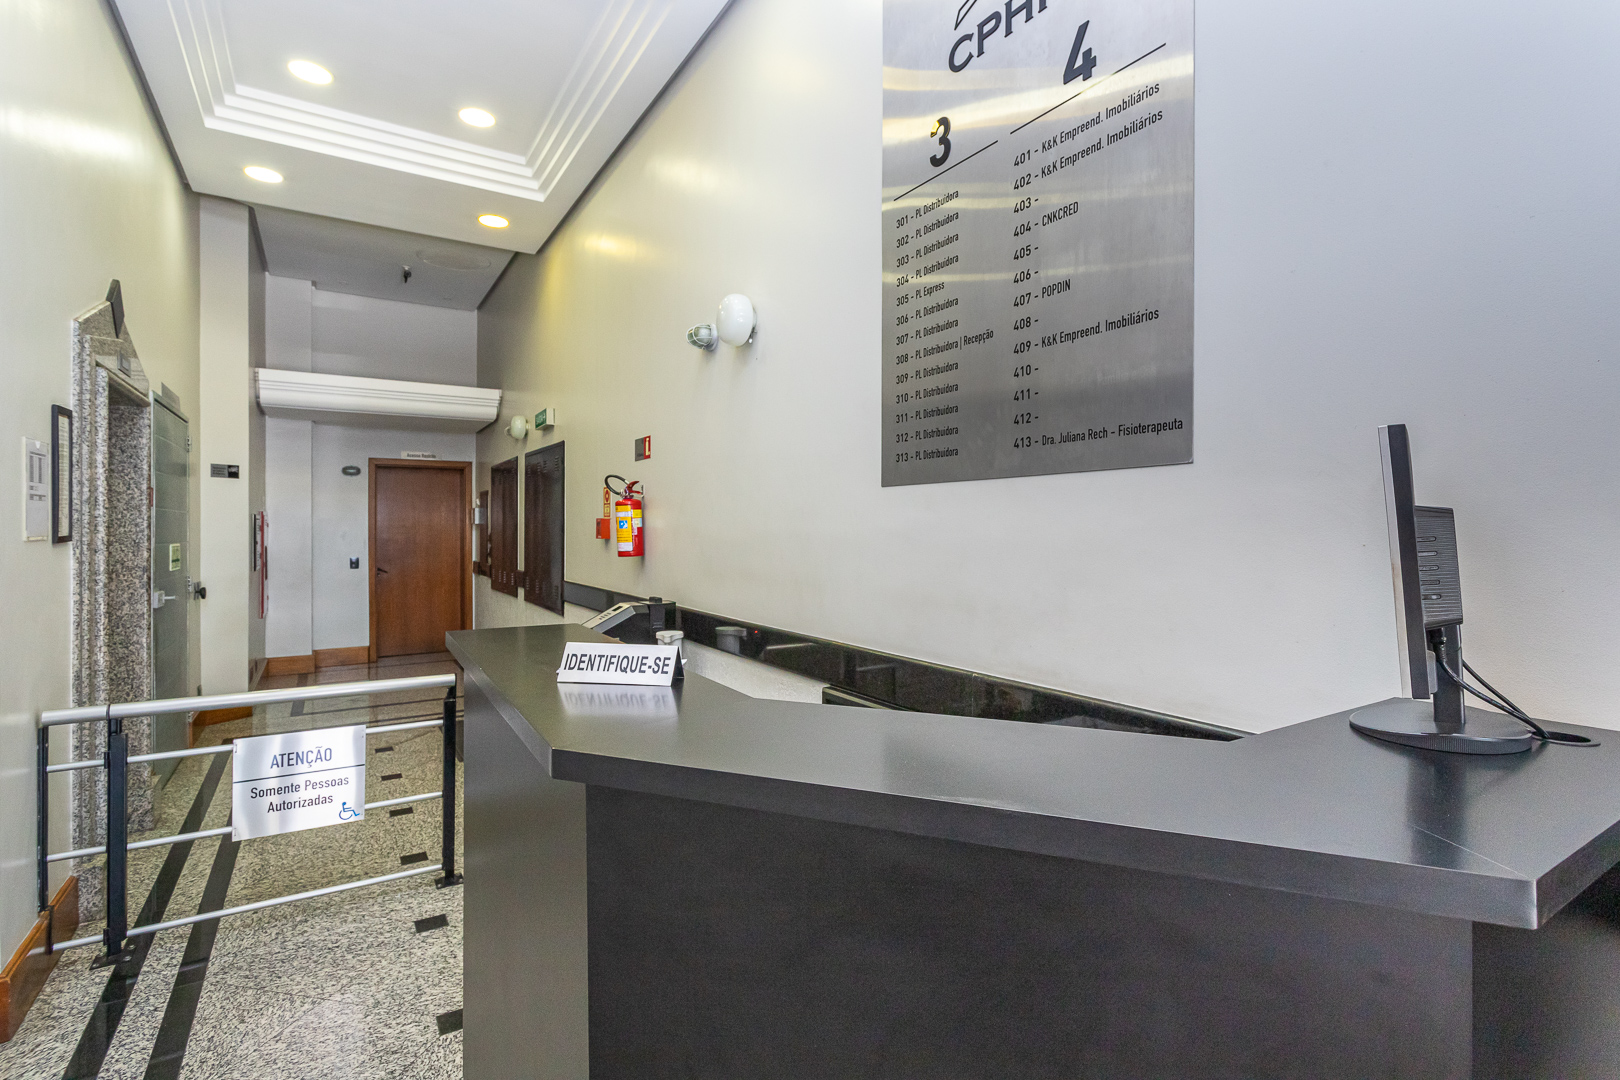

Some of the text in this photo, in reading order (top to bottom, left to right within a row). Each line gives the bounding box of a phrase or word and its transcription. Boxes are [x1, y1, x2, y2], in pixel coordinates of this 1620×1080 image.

[1062, 19, 1097, 86] 4
[1013, 149, 1031, 167] 401
[1041, 134, 1058, 154] K&K
[1059, 111, 1104, 144] Empreend.
[1105, 83, 1160, 120] Imobiliários
[929, 116, 952, 168] 3
[1013, 172, 1032, 191] 402
[1041, 159, 1058, 179] K&K
[1059, 137, 1105, 170] Empreend.
[1106, 110, 1163, 147] Imobiliários
[896, 214, 909, 229] 301
[915, 207, 923, 219] PL
[923, 190, 959, 215] Distribuidora
[1013, 196, 1032, 214] 403
[896, 234, 909, 249] 302
[915, 228, 923, 240] PL
[923, 211, 959, 236] Distribuidora
[1013, 220, 1032, 237] 404
[1041, 201, 1079, 227] CNKCRED
[896, 254, 910, 268] 303
[915, 248, 923, 260] PL
[923, 233, 959, 256] Distribuidora
[1013, 244, 1032, 261] 405
[896, 273, 909, 288] 304
[915, 268, 923, 280] PL
[923, 254, 959, 276] Distribuidora
[1013, 268, 1032, 284] 406
[896, 293, 909, 307] 305
[915, 288, 923, 300] PL
[923, 281, 945, 297] Express
[1013, 291, 1032, 308] 407
[1041, 278, 1071, 299] POPDIN
[896, 313, 909, 327] 306
[915, 309, 923, 320] PL
[923, 297, 959, 317] Distribuidora
[1013, 316, 1032, 331] 408
[895, 332, 909, 346] 307
[915, 329, 922, 340] PL
[923, 319, 959, 338] Distribuidora
[1013, 340, 1032, 355] 409
[1041, 332, 1058, 348] K&K
[1059, 321, 1103, 344] Empreend.
[1105, 308, 1160, 332] Imobiliários
[895, 353, 909, 366] 308
[915, 349, 923, 360] PL
[923, 340, 959, 358] Distribuidora
[963, 328, 994, 346] Recepção
[895, 372, 909, 385] 309
[915, 369, 922, 380] PL
[923, 362, 959, 378] Distribuidora
[1013, 364, 1032, 378] 410
[895, 392, 909, 405] 310
[915, 389, 922, 400] PL
[923, 383, 959, 399] Distribuidora
[1013, 388, 1031, 402] 411
[895, 412, 908, 424] 311
[915, 410, 922, 420] PL
[923, 404, 959, 419] Distribuidora
[1013, 412, 1032, 425] 412
[895, 432, 909, 444] 312
[915, 430, 922, 440] PL
[923, 425, 959, 440] Distribuidora
[1013, 436, 1032, 449] 413
[1042, 434, 1058, 446] Dra.
[1058, 431, 1086, 444] Juliana
[1087, 426, 1108, 440] Rech
[1118, 417, 1183, 437] Fisioterapeuta
[895, 452, 909, 463] 313
[915, 450, 922, 461] PL
[923, 447, 959, 460] Distribuidora
[563, 653, 671, 675] IDENTIFIQUE-SE
[270, 745, 333, 769] ATENÇÃO
[250, 776, 350, 799] Somente Pessoas
[267, 794, 334, 813] Autorizadas
